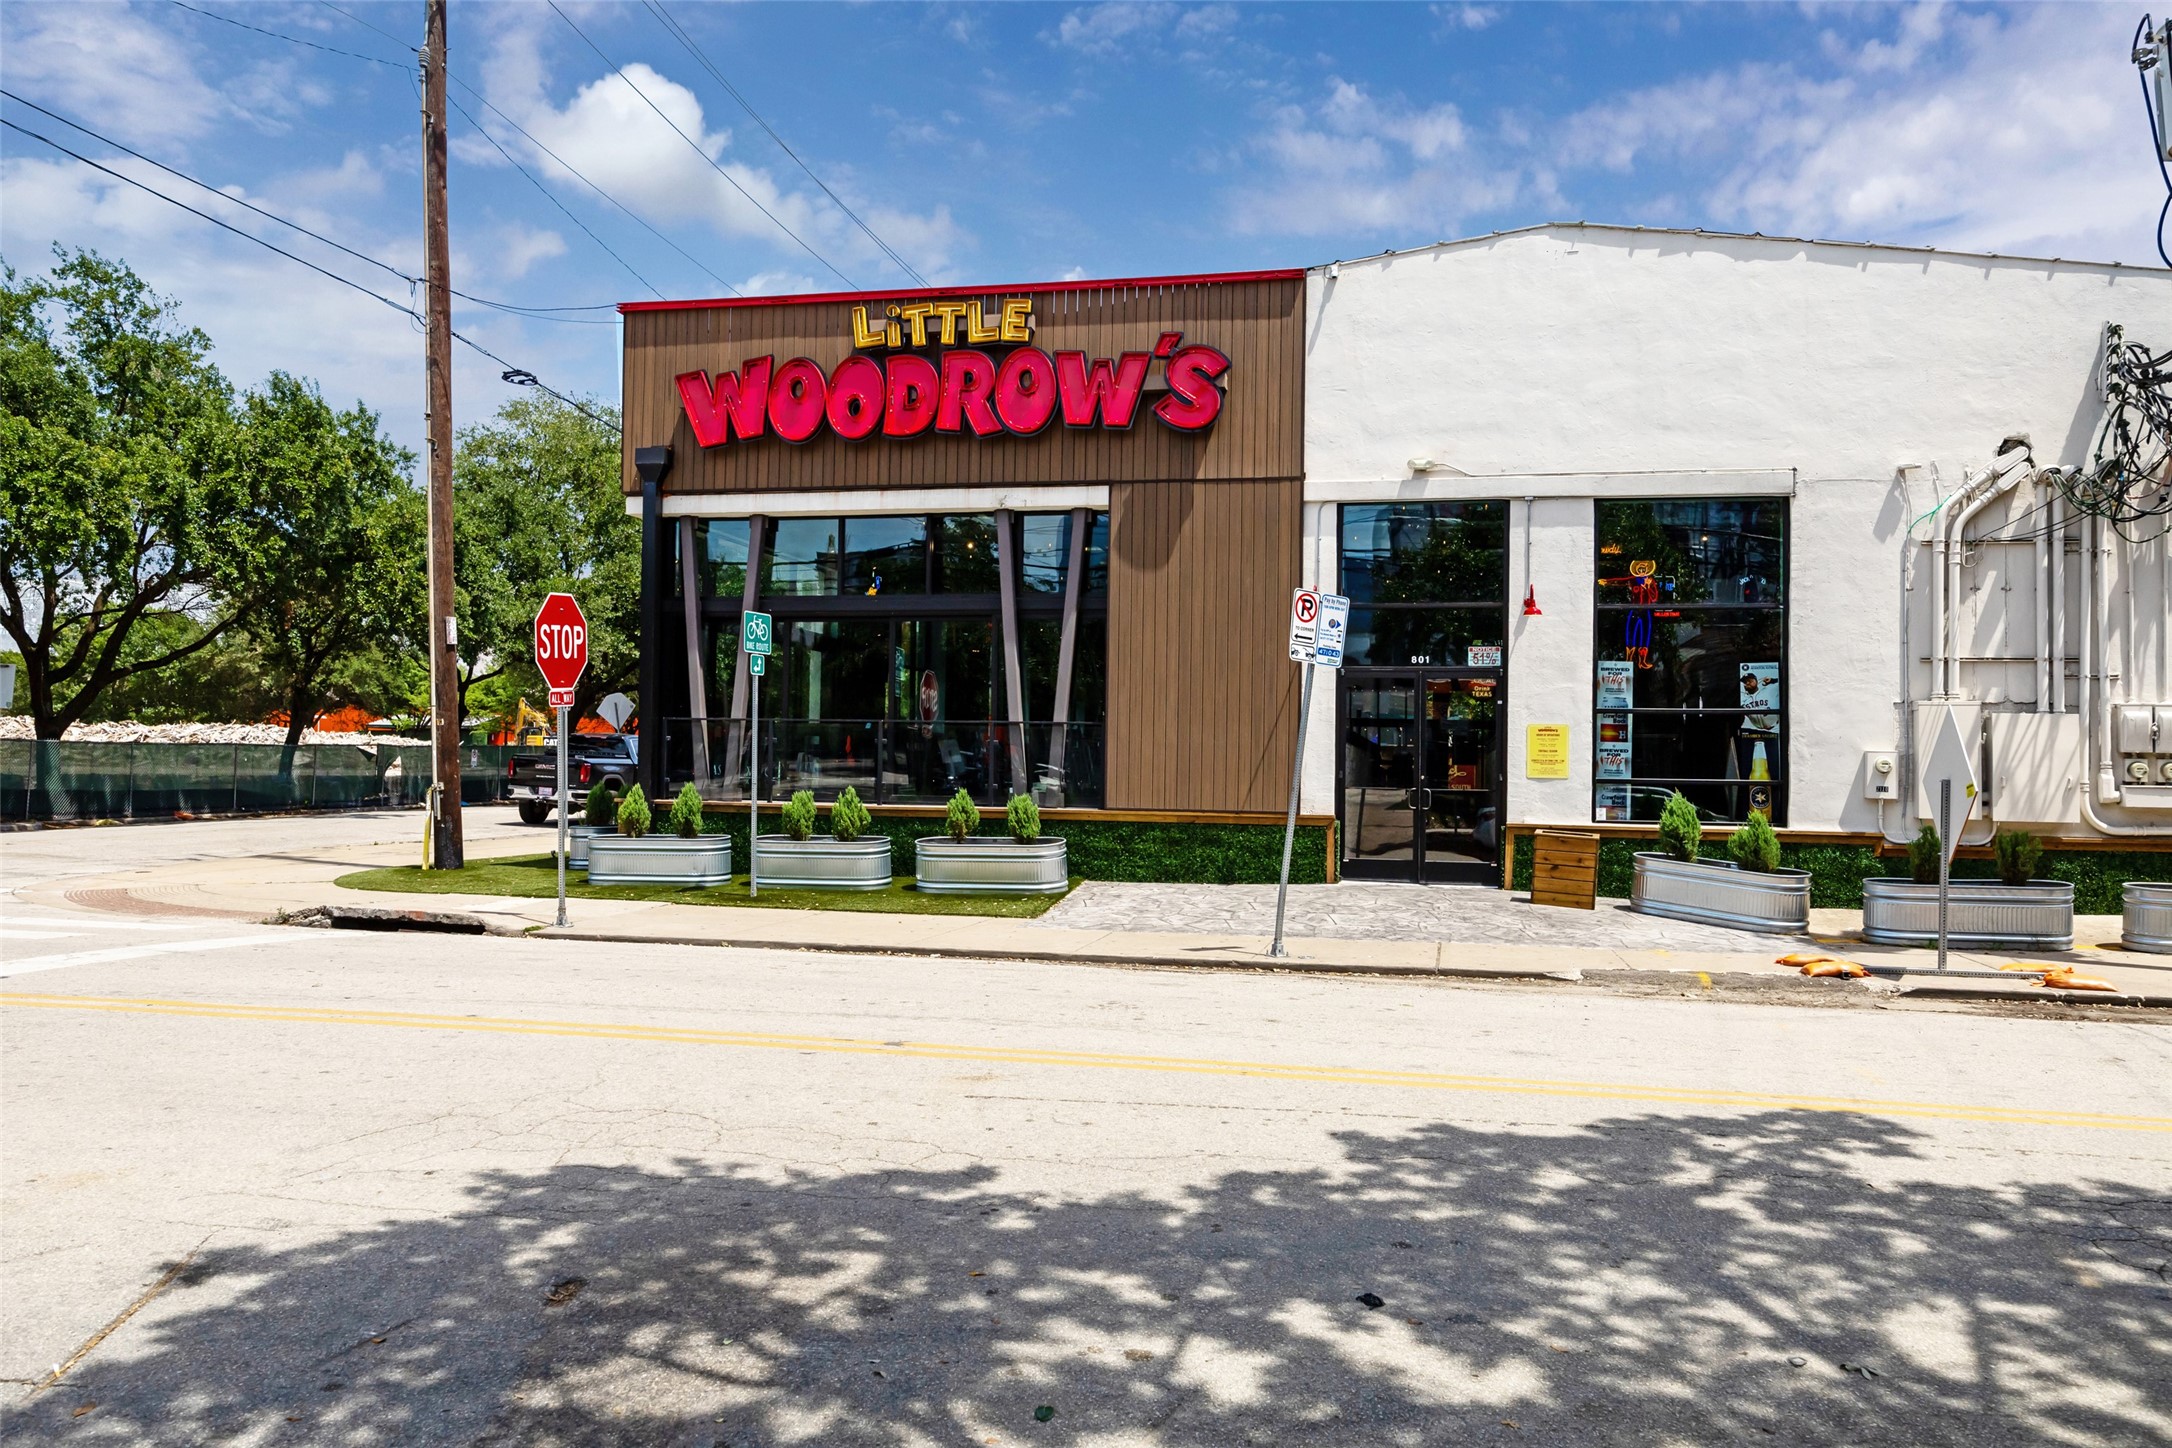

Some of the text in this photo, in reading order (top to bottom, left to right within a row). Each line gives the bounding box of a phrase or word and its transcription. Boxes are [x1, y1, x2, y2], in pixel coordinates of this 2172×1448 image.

[675, 331, 1231, 449] WOODROW'S
[539, 624, 584, 659] STOP
[746, 641, 769, 652] BIKE ROUTE
[1411, 655, 1430, 664] 801
[1473, 653, 1497, 665] 51%
[551, 693, 573, 703] ALL WAY
